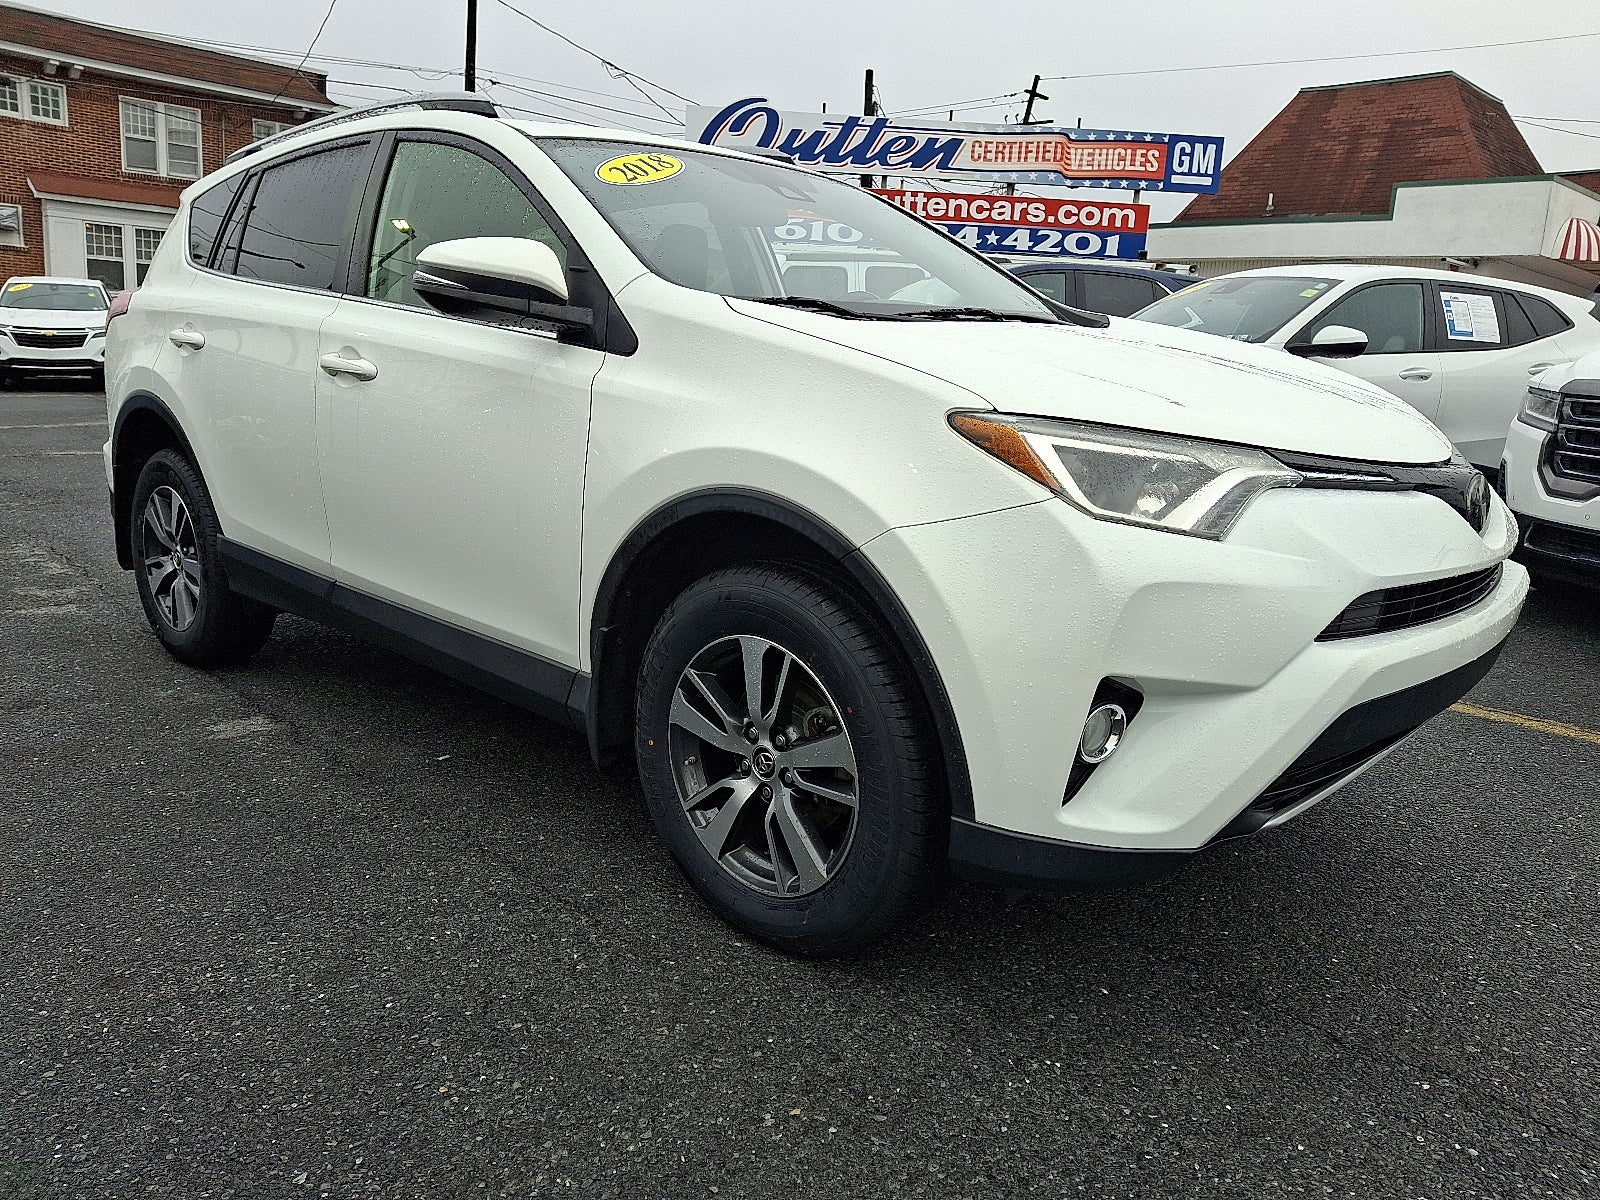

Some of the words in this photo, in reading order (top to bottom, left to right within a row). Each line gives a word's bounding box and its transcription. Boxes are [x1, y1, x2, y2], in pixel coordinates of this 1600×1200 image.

[698, 97, 966, 172] Outten
[608, 154, 675, 182] 2018
[970, 139, 1065, 164] CERTIFIED
[1070, 147, 1160, 173] VEHICLES
[1172, 141, 1217, 175] GM
